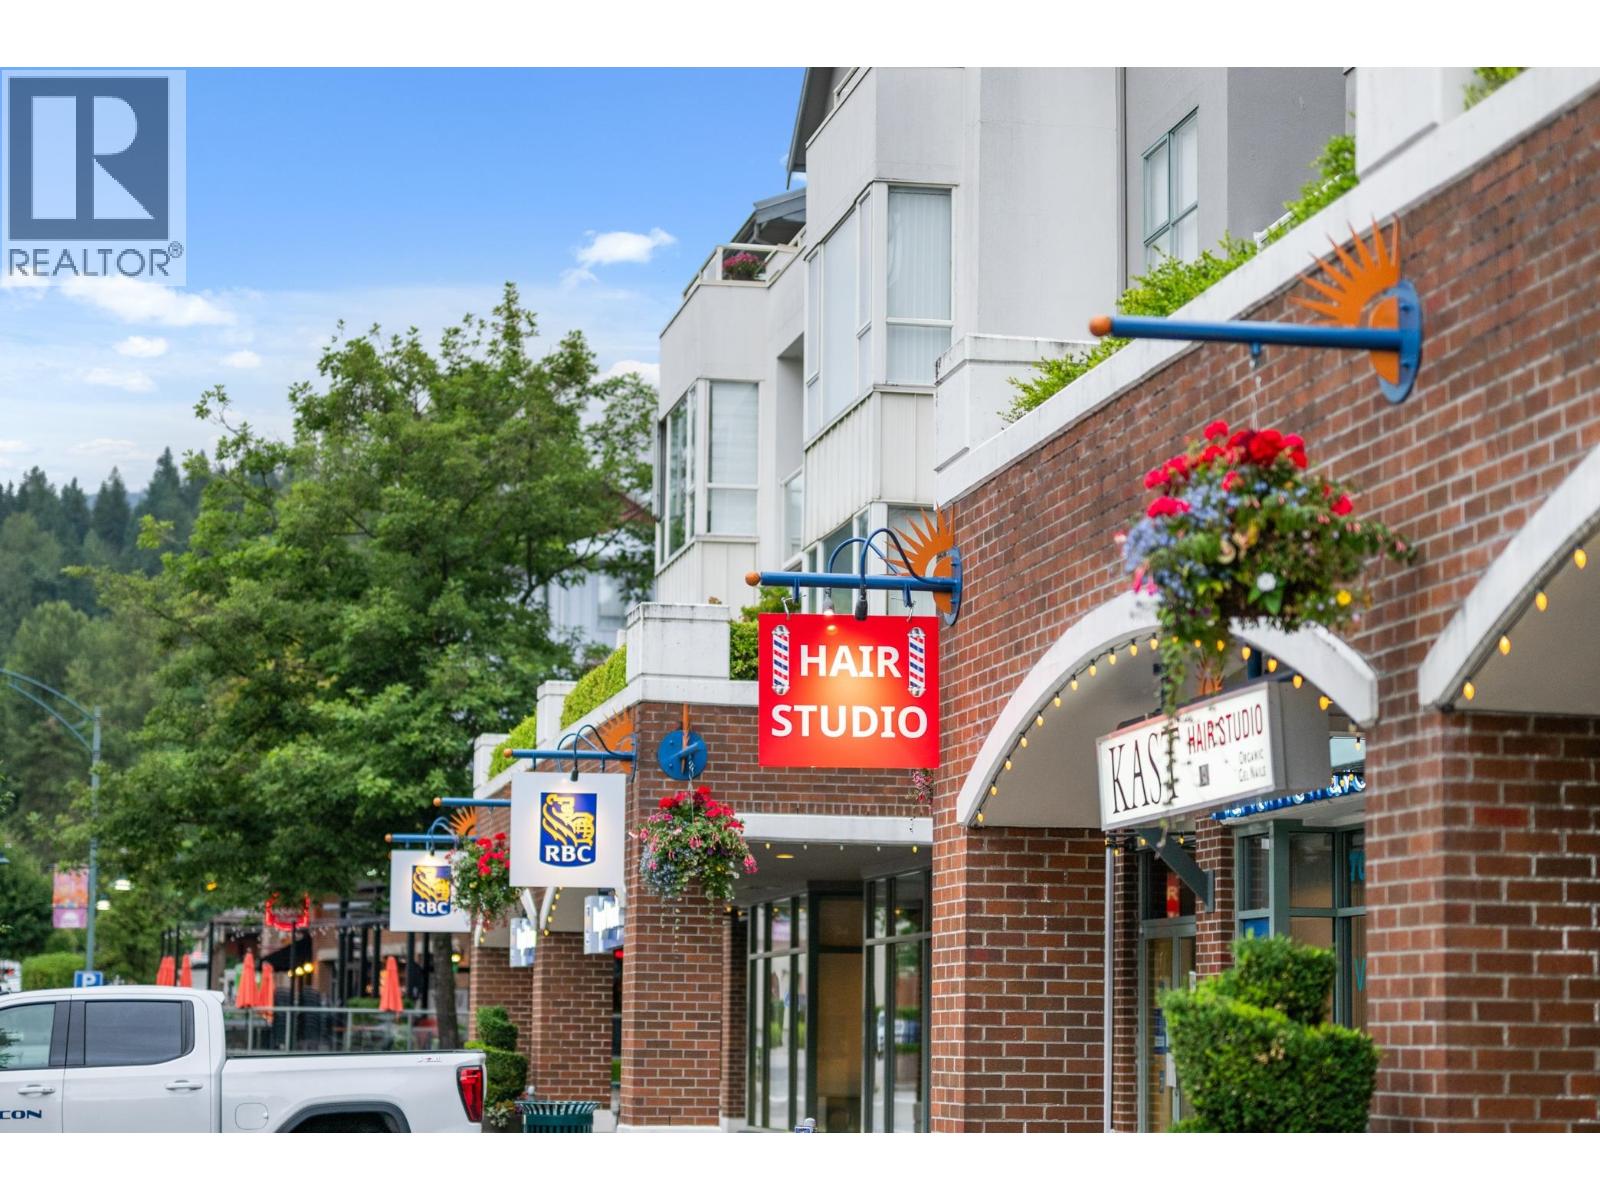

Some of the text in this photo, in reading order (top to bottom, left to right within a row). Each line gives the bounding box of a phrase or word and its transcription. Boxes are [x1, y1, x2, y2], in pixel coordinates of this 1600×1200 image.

[800, 644, 902, 678] HAIR
[771, 704, 928, 739] STUDIO
[545, 845, 592, 863] RBC
[415, 901, 449, 915] RBC
[82, 972, 97, 987] P
